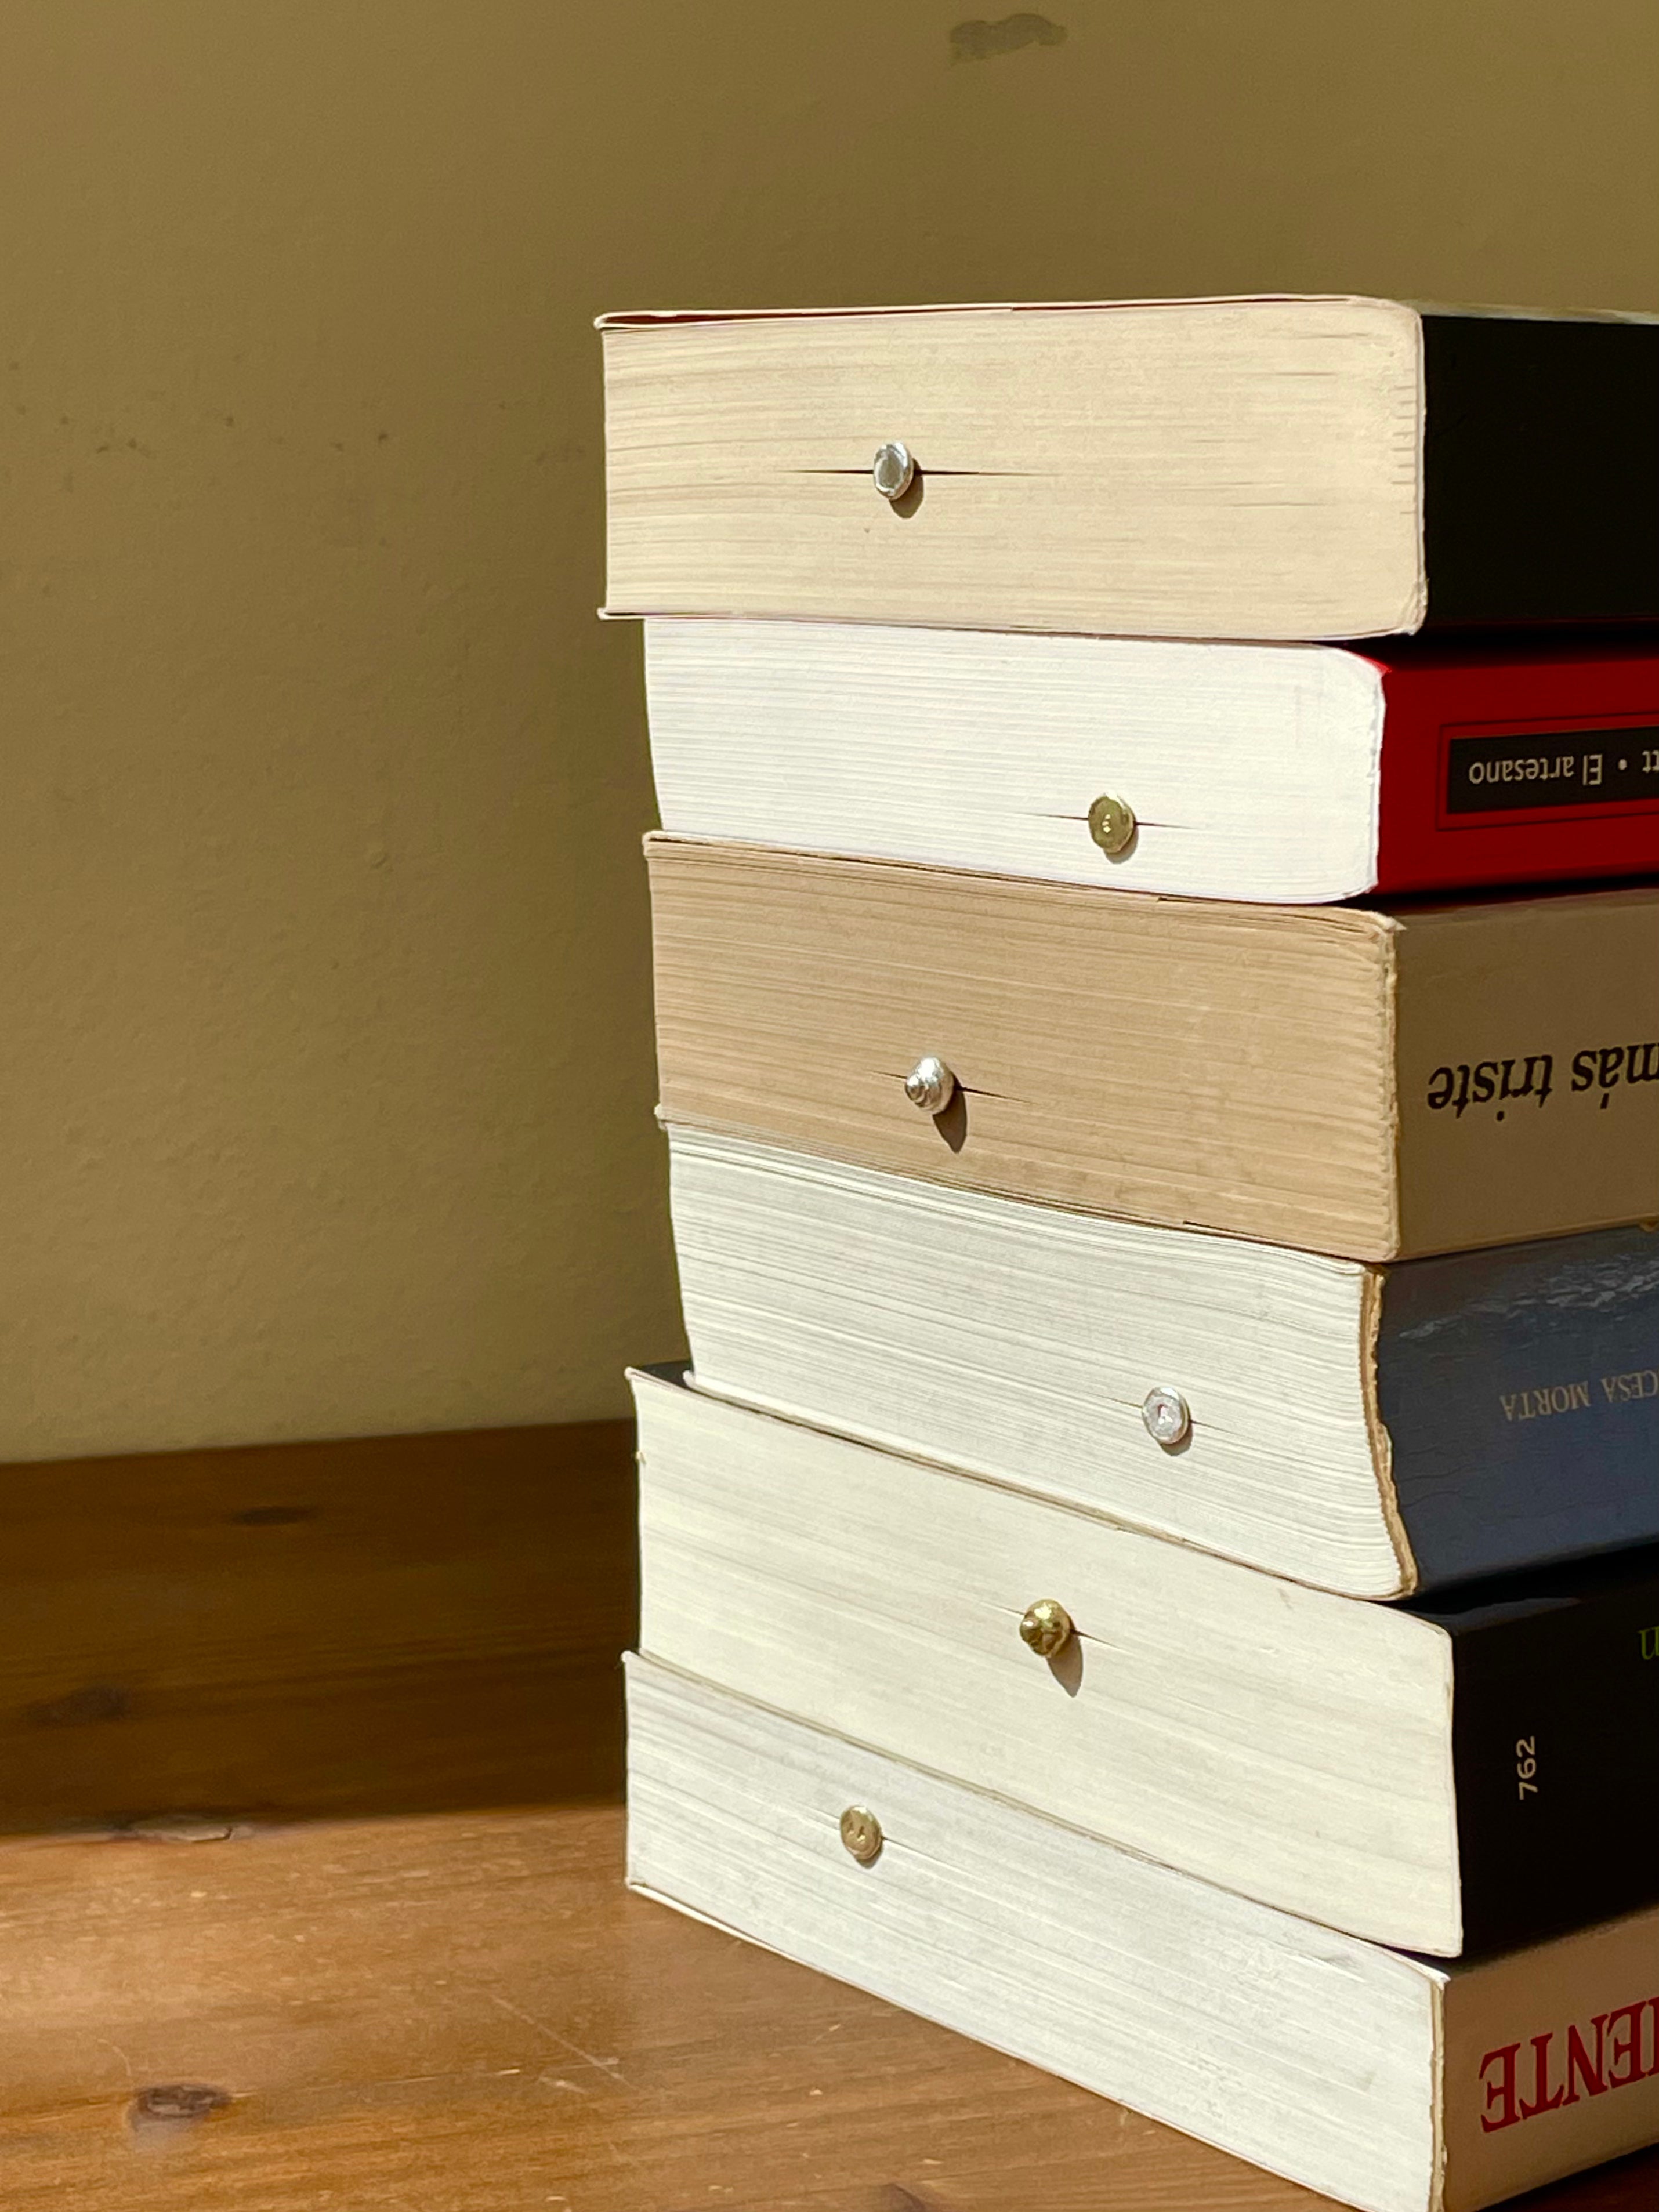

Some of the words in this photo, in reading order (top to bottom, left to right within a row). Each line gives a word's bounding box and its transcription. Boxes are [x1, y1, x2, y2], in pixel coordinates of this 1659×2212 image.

[1468, 756, 1575, 784] artesano
[1582, 753, 1603, 786] El
[1427, 1054, 1553, 1122] triste
[1571, 1042, 1659, 1110] más
[1499, 1381, 1591, 1421] MORTA
[1516, 1736, 1538, 1800] 762
